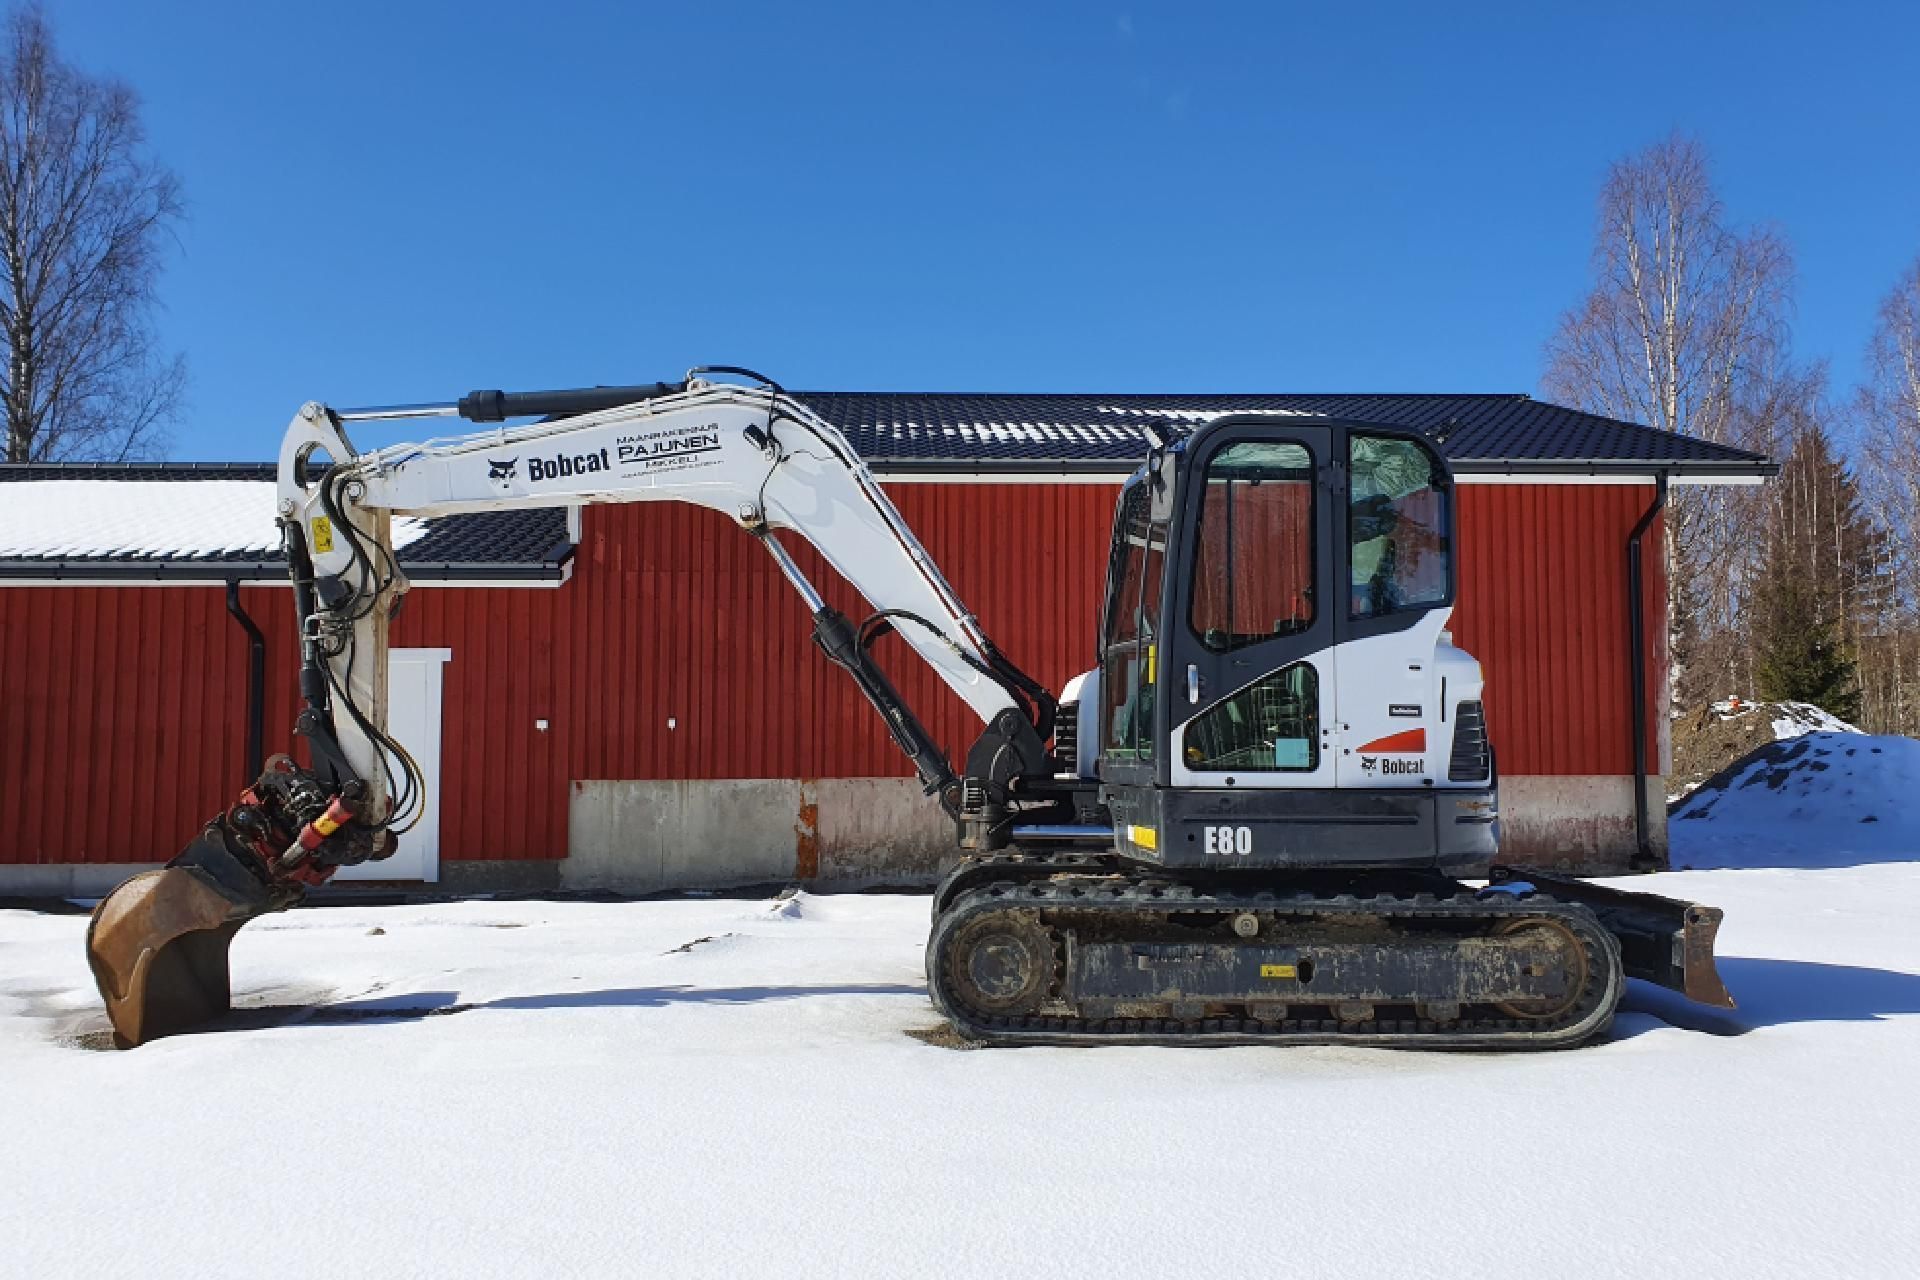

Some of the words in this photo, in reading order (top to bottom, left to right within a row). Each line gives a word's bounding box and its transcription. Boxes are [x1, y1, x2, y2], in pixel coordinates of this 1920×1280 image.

[619, 433, 718, 459] PAJUNEN
[529, 447, 611, 481] Bobcat
[1382, 758, 1425, 775] Bobcat
[1204, 826, 1252, 855] E80
